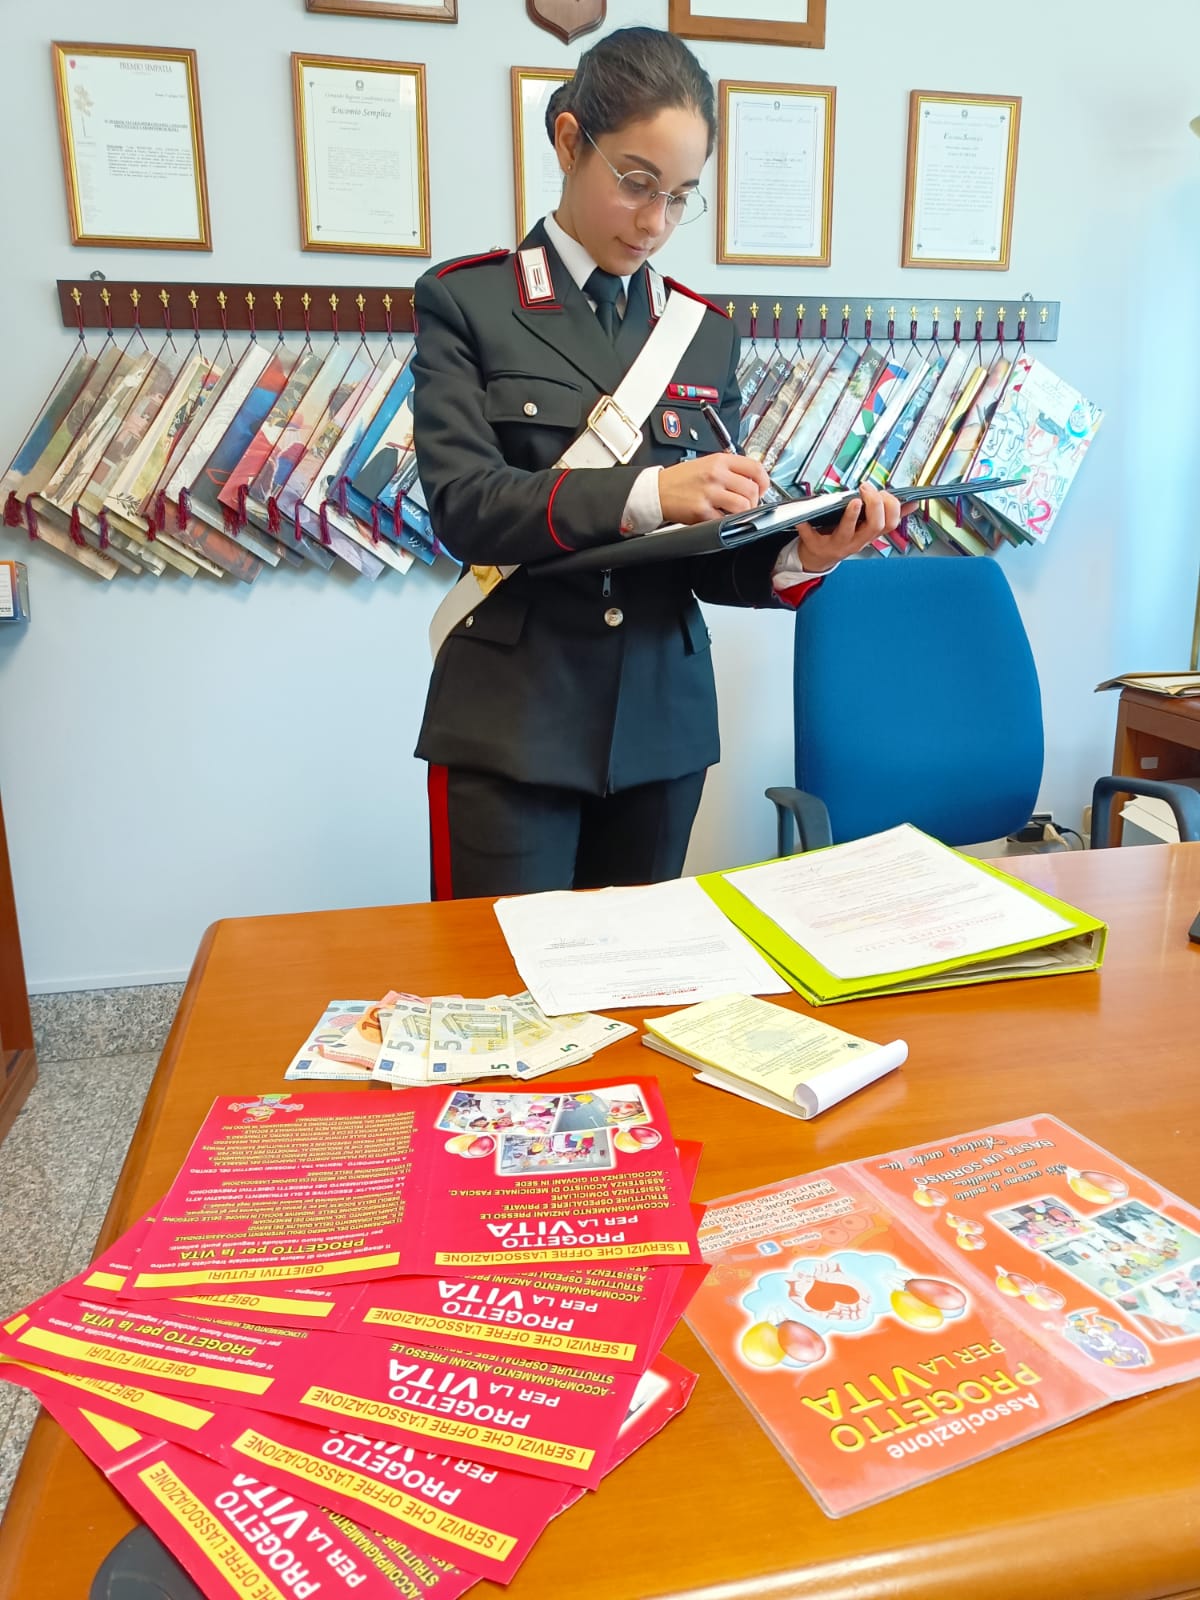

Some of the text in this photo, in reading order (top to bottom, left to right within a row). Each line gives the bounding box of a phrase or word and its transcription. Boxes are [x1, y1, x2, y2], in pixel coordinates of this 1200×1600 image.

[145, 64, 172, 72] SIMPATIA
[332, 105, 392, 119] Encomio Semplice
[603, 1023, 622, 1032] 5
[387, 1039, 415, 1053] 5
[434, 1040, 462, 1052] 5
[559, 1043, 579, 1053] 5
[905, 1150, 950, 1167] anche
[911, 1138, 1056, 1187] BASTA UN SORRISO
[1015, 1159, 1041, 1170] non
[601, 1169, 662, 1180] ACCOGLIENZA
[610, 1177, 664, 1188] ASSISTENZA
[551, 1185, 666, 1200] ASSISTENZA DOMICILIARE
[562, 1182, 607, 1191] ACQUISTO
[814, 1186, 836, 1195] PER
[950, 1185, 992, 1202] malato
[987, 1182, 1004, 1192] il
[551, 1197, 613, 1208] OSPEDALIERE
[616, 1193, 668, 1203] STRUTTURE
[762, 1192, 817, 1211] DONAZIONE
[572, 1201, 669, 1215] ACCOMPAGNAMENTO
[484, 1214, 638, 1237] PER LA VITA
[501, 1231, 624, 1248] PROGETTO
[626, 1242, 673, 1254] SERVIZI
[177, 1238, 363, 1260] PROGETTO per la VITA
[316, 1249, 351, 1258] operativo
[442, 1250, 546, 1262] L'ASSOCIAZIONE
[550, 1248, 590, 1258] OFFRE
[594, 1246, 622, 1256] CHE
[259, 1264, 324, 1277] OBIETTIVI
[491, 1274, 640, 1302] ACCOMPAGNAMENTO ANZIANI
[583, 1277, 644, 1292] STRUTTURE
[433, 1279, 598, 1312] PER LA VITA
[372, 1309, 482, 1335] L'ASSOCIAZIONE
[440, 1299, 574, 1332] PROGETTO
[80, 1311, 257, 1356] PROGETTO per la VITA
[483, 1326, 530, 1342] OFFRE
[532, 1333, 564, 1347] CHE
[565, 1338, 620, 1354] SERVIZI
[85, 1346, 197, 1377] OBIETTIVI FUTURI
[197, 1350, 235, 1363] operativo
[234, 1357, 267, 1368] disegno
[388, 1342, 609, 1396] ACCOMPAGNAMENTO ANZIANI PRESSO LE
[378, 1358, 562, 1407] PER LA VITA
[797, 1336, 1007, 1426] PER LA VITA
[308, 1389, 429, 1428] L'ASSOCIAZIONE
[385, 1384, 532, 1429] PROGETTO
[822, 1360, 1044, 1456] PROGETTO
[427, 1418, 480, 1439] OFFRE
[882, 1391, 1045, 1462] Associazione
[478, 1429, 515, 1447] CHE
[515, 1437, 577, 1460] SERVIZI
[318, 1435, 462, 1505] PROGETTO
[451, 1458, 498, 1484] PER
[242, 1434, 507, 1550] I SERVIZI CHE OFFRE L'ASSOCIAZIONE
[146, 1467, 264, 1586] OFFRE L'ASSOCIAZIONE
[215, 1491, 320, 1600] PROGETTO
[306, 1527, 333, 1552] LA
[327, 1553, 367, 1588] PER
